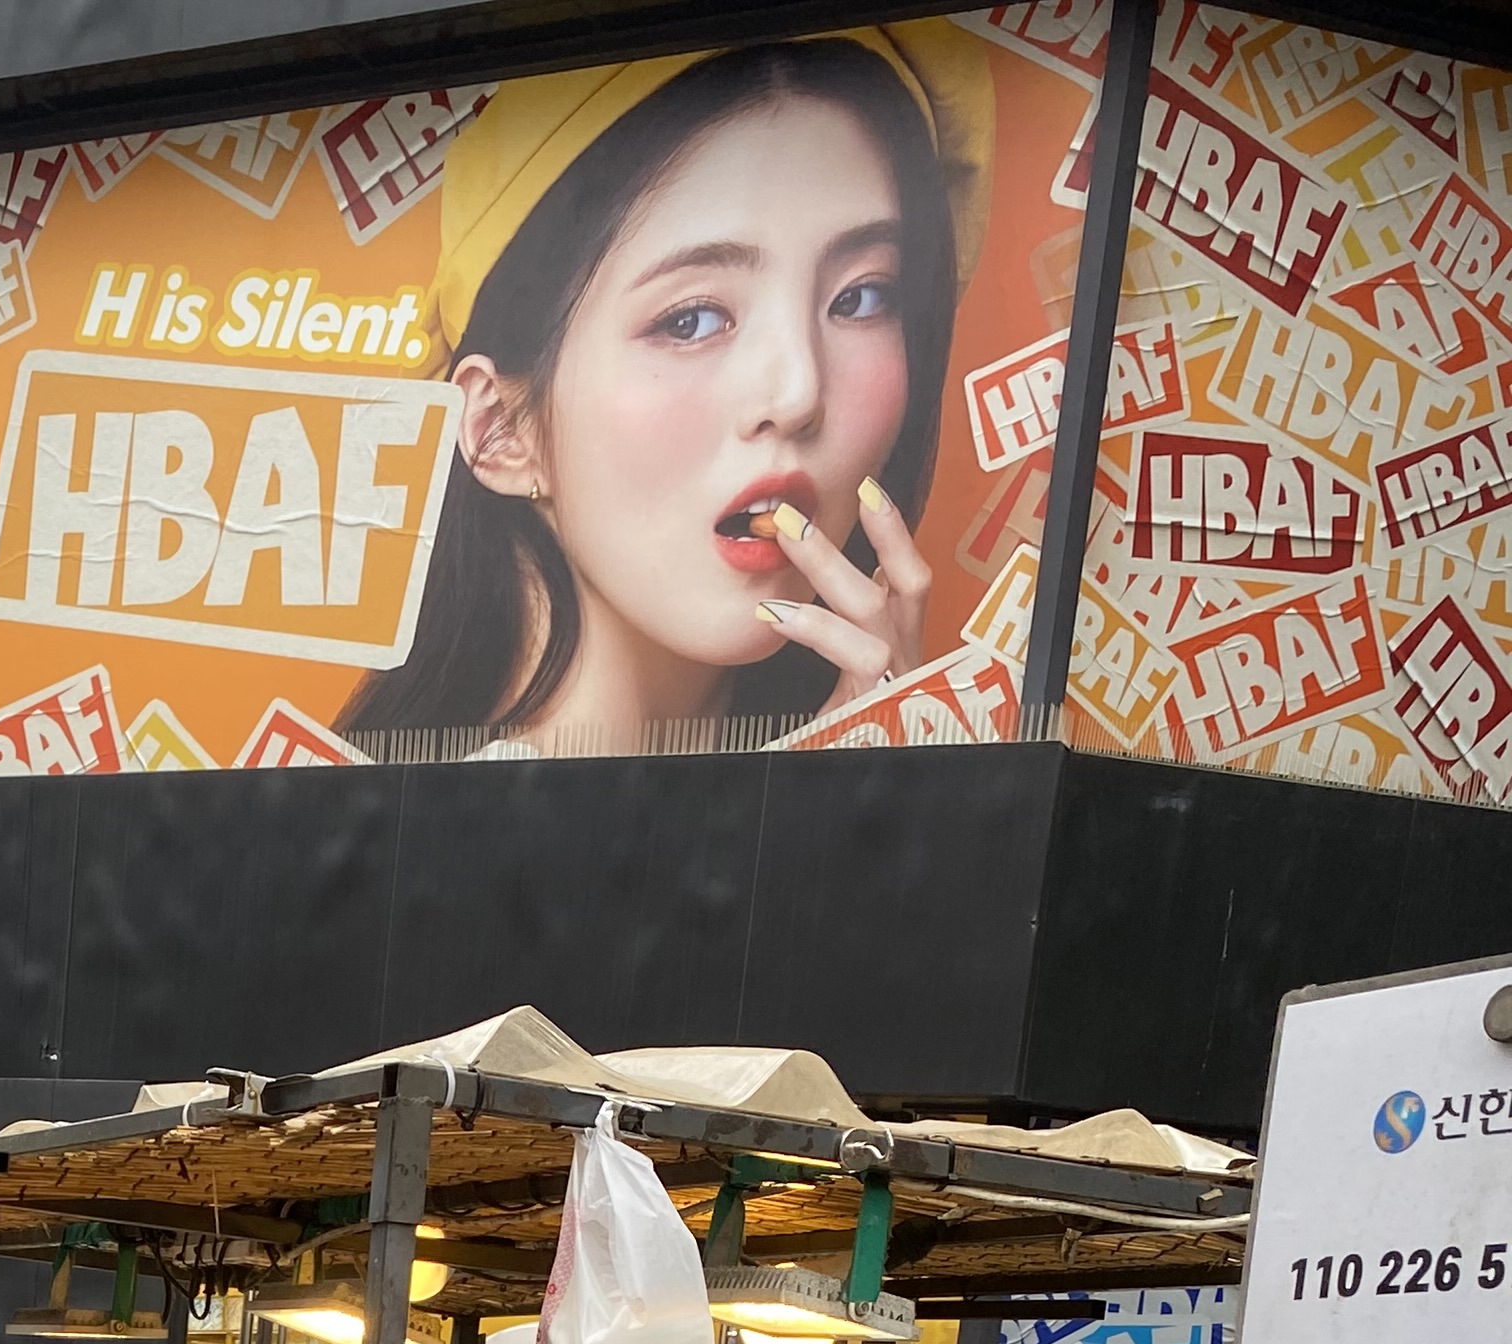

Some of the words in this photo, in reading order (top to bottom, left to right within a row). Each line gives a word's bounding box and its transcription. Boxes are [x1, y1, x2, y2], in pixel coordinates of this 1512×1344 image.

[1135, 95, 1338, 286] HBAF
[82, 270, 146, 338] H
[150, 273, 206, 344] is
[217, 277, 423, 359] Silent.
[1237, 318, 1478, 460] HBAF
[25, 405, 420, 606] HBAF
[1148, 453, 1352, 562] HBAF
[1171, 582, 1368, 755] HBAF
[1291, 1252, 1364, 1301] 110
[1376, 1246, 1462, 1295] 226
